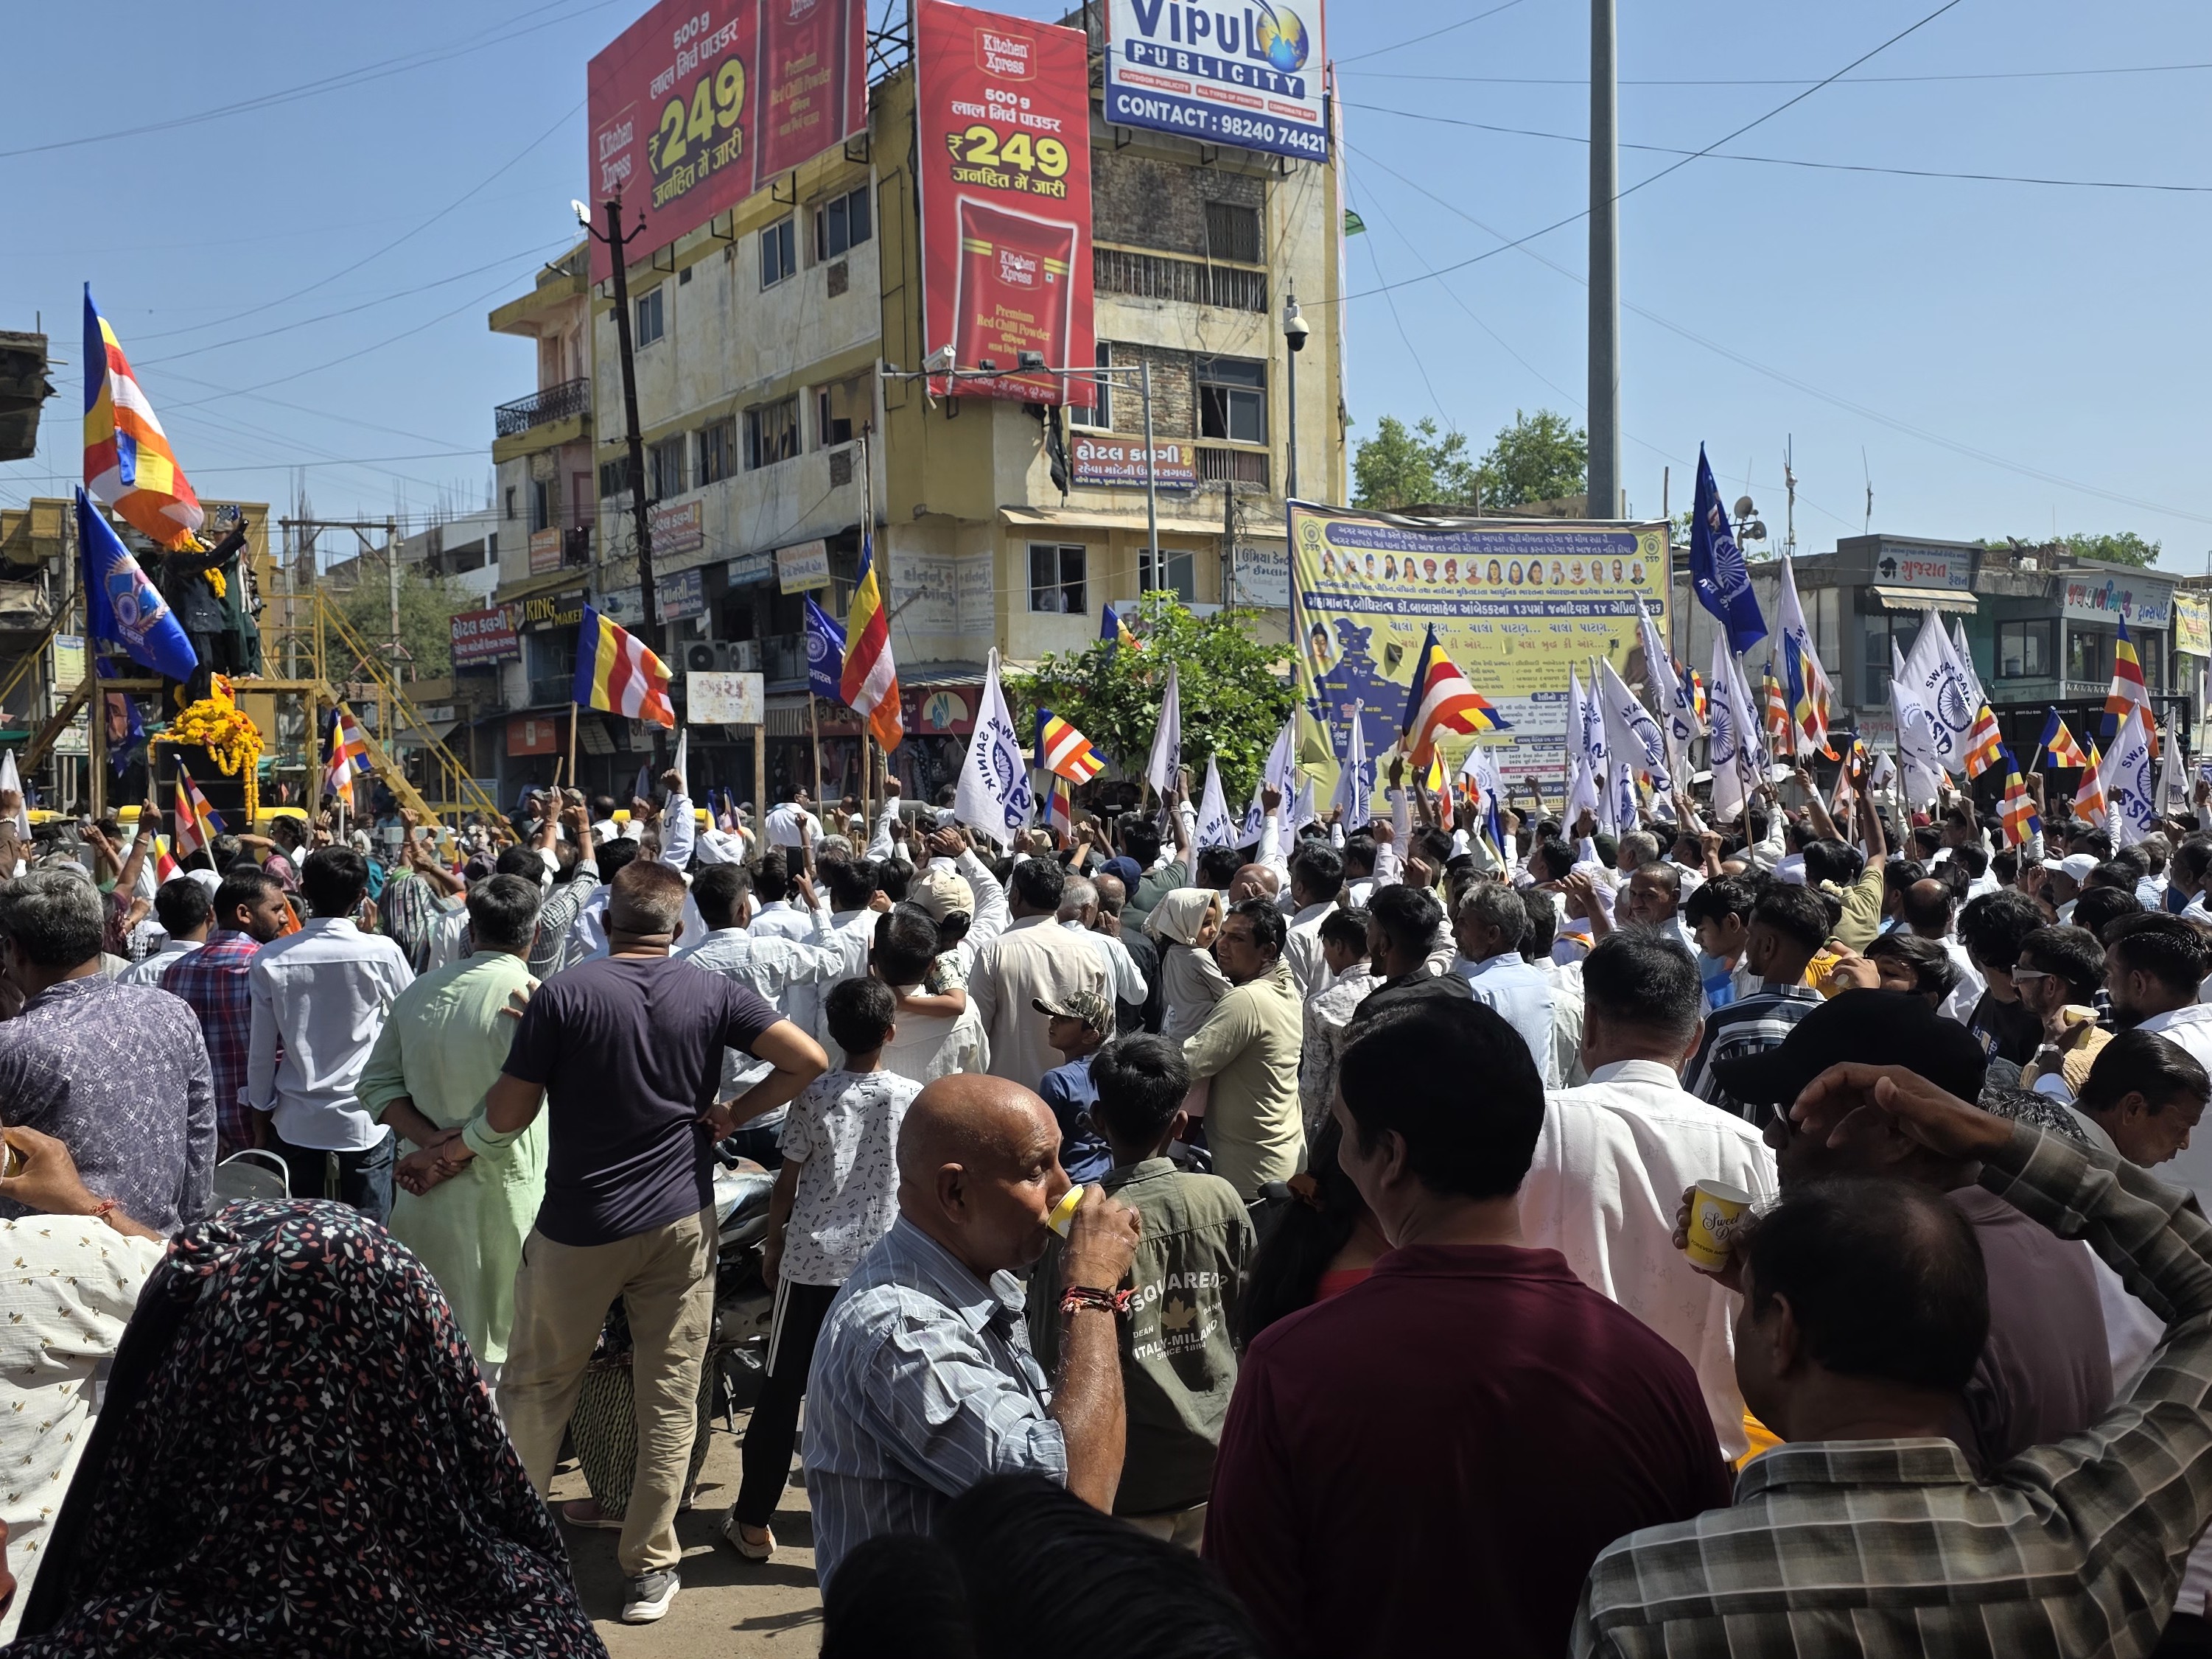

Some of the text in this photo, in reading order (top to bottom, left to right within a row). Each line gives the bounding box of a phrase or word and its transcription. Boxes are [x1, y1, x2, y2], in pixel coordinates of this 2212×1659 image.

[673, 11, 710, 49] 500 g
[983, 34, 1028, 58] Kitchen
[650, 18, 738, 99] लाल मिर्च पाउडर
[986, 52, 1024, 74] Xpress
[1133, 43, 1298, 96] PUBLICITY
[1121, 71, 1189, 92] OUTDOOR PUBLICITY
[985, 88, 1030, 109] 500 g
[1198, 87, 1208, 97] ALL
[1209, 90, 1227, 100] TYPES
[1228, 94, 1236, 102] OF
[648, 59, 746, 174] ₹249
[951, 101, 1061, 133] लाल मिर्च पाउडर
[1270, 103, 1301, 117] CORPORATE
[1117, 95, 1208, 128] CONTACT
[1221, 115, 1275, 142] 98240
[1278, 127, 1326, 153] 74421
[598, 121, 633, 161] Kitchen
[948, 126, 1068, 177] ₹249
[601, 154, 631, 193] Xpress
[653, 130, 742, 208] जनहित में जारी
[953, 167, 1065, 197] जनहित में जारी
[1001, 266, 1032, 284] Xpress
[996, 304, 1034, 322] Premium
[977, 314, 1051, 340] Red Chilli Powder
[1077, 440, 1123, 460] હોટલ
[1078, 463, 1192, 477] રહેવા માટેની સગવડ
[1331, 536, 1349, 545] અગર
[1338, 526, 1356, 536] અગર
[1357, 528, 1372, 536] આપ
[1304, 543, 1320, 552] SSD
[1901, 560, 1946, 581] ગુજરાત
[1948, 572, 1967, 586] ફેશન
[526, 597, 555, 621] KING
[1460, 600, 1509, 614] આંબેડકરના
[1548, 600, 1589, 614] જન્મદિવસ
[1594, 604, 1606, 614] ૧૪
[1611, 600, 1636, 614] એપ્રિલ
[1645, 603, 1661, 613] ૦૨૬
[2138, 601, 2169, 621] ટ્રાન્સપોર્ટ
[452, 609, 507, 639] હોટલ કલગી
[1390, 619, 1413, 631] ચાલો
[1469, 620, 1493, 632] ચાલો
[1549, 620, 1572, 632] ચાલો
[1401, 637, 1418, 648] ચલો
[1450, 637, 1457, 648] કી
[1518, 638, 1536, 648] ચલો
[1564, 638, 1572, 648] કી
[1691, 1239, 1712, 1252] FOREVER
[1133, 1325, 1154, 1339] DEAN
[1135, 1319, 1218, 1359] ITALY-MILANO
[1157, 1347, 1181, 1361] SINCE
